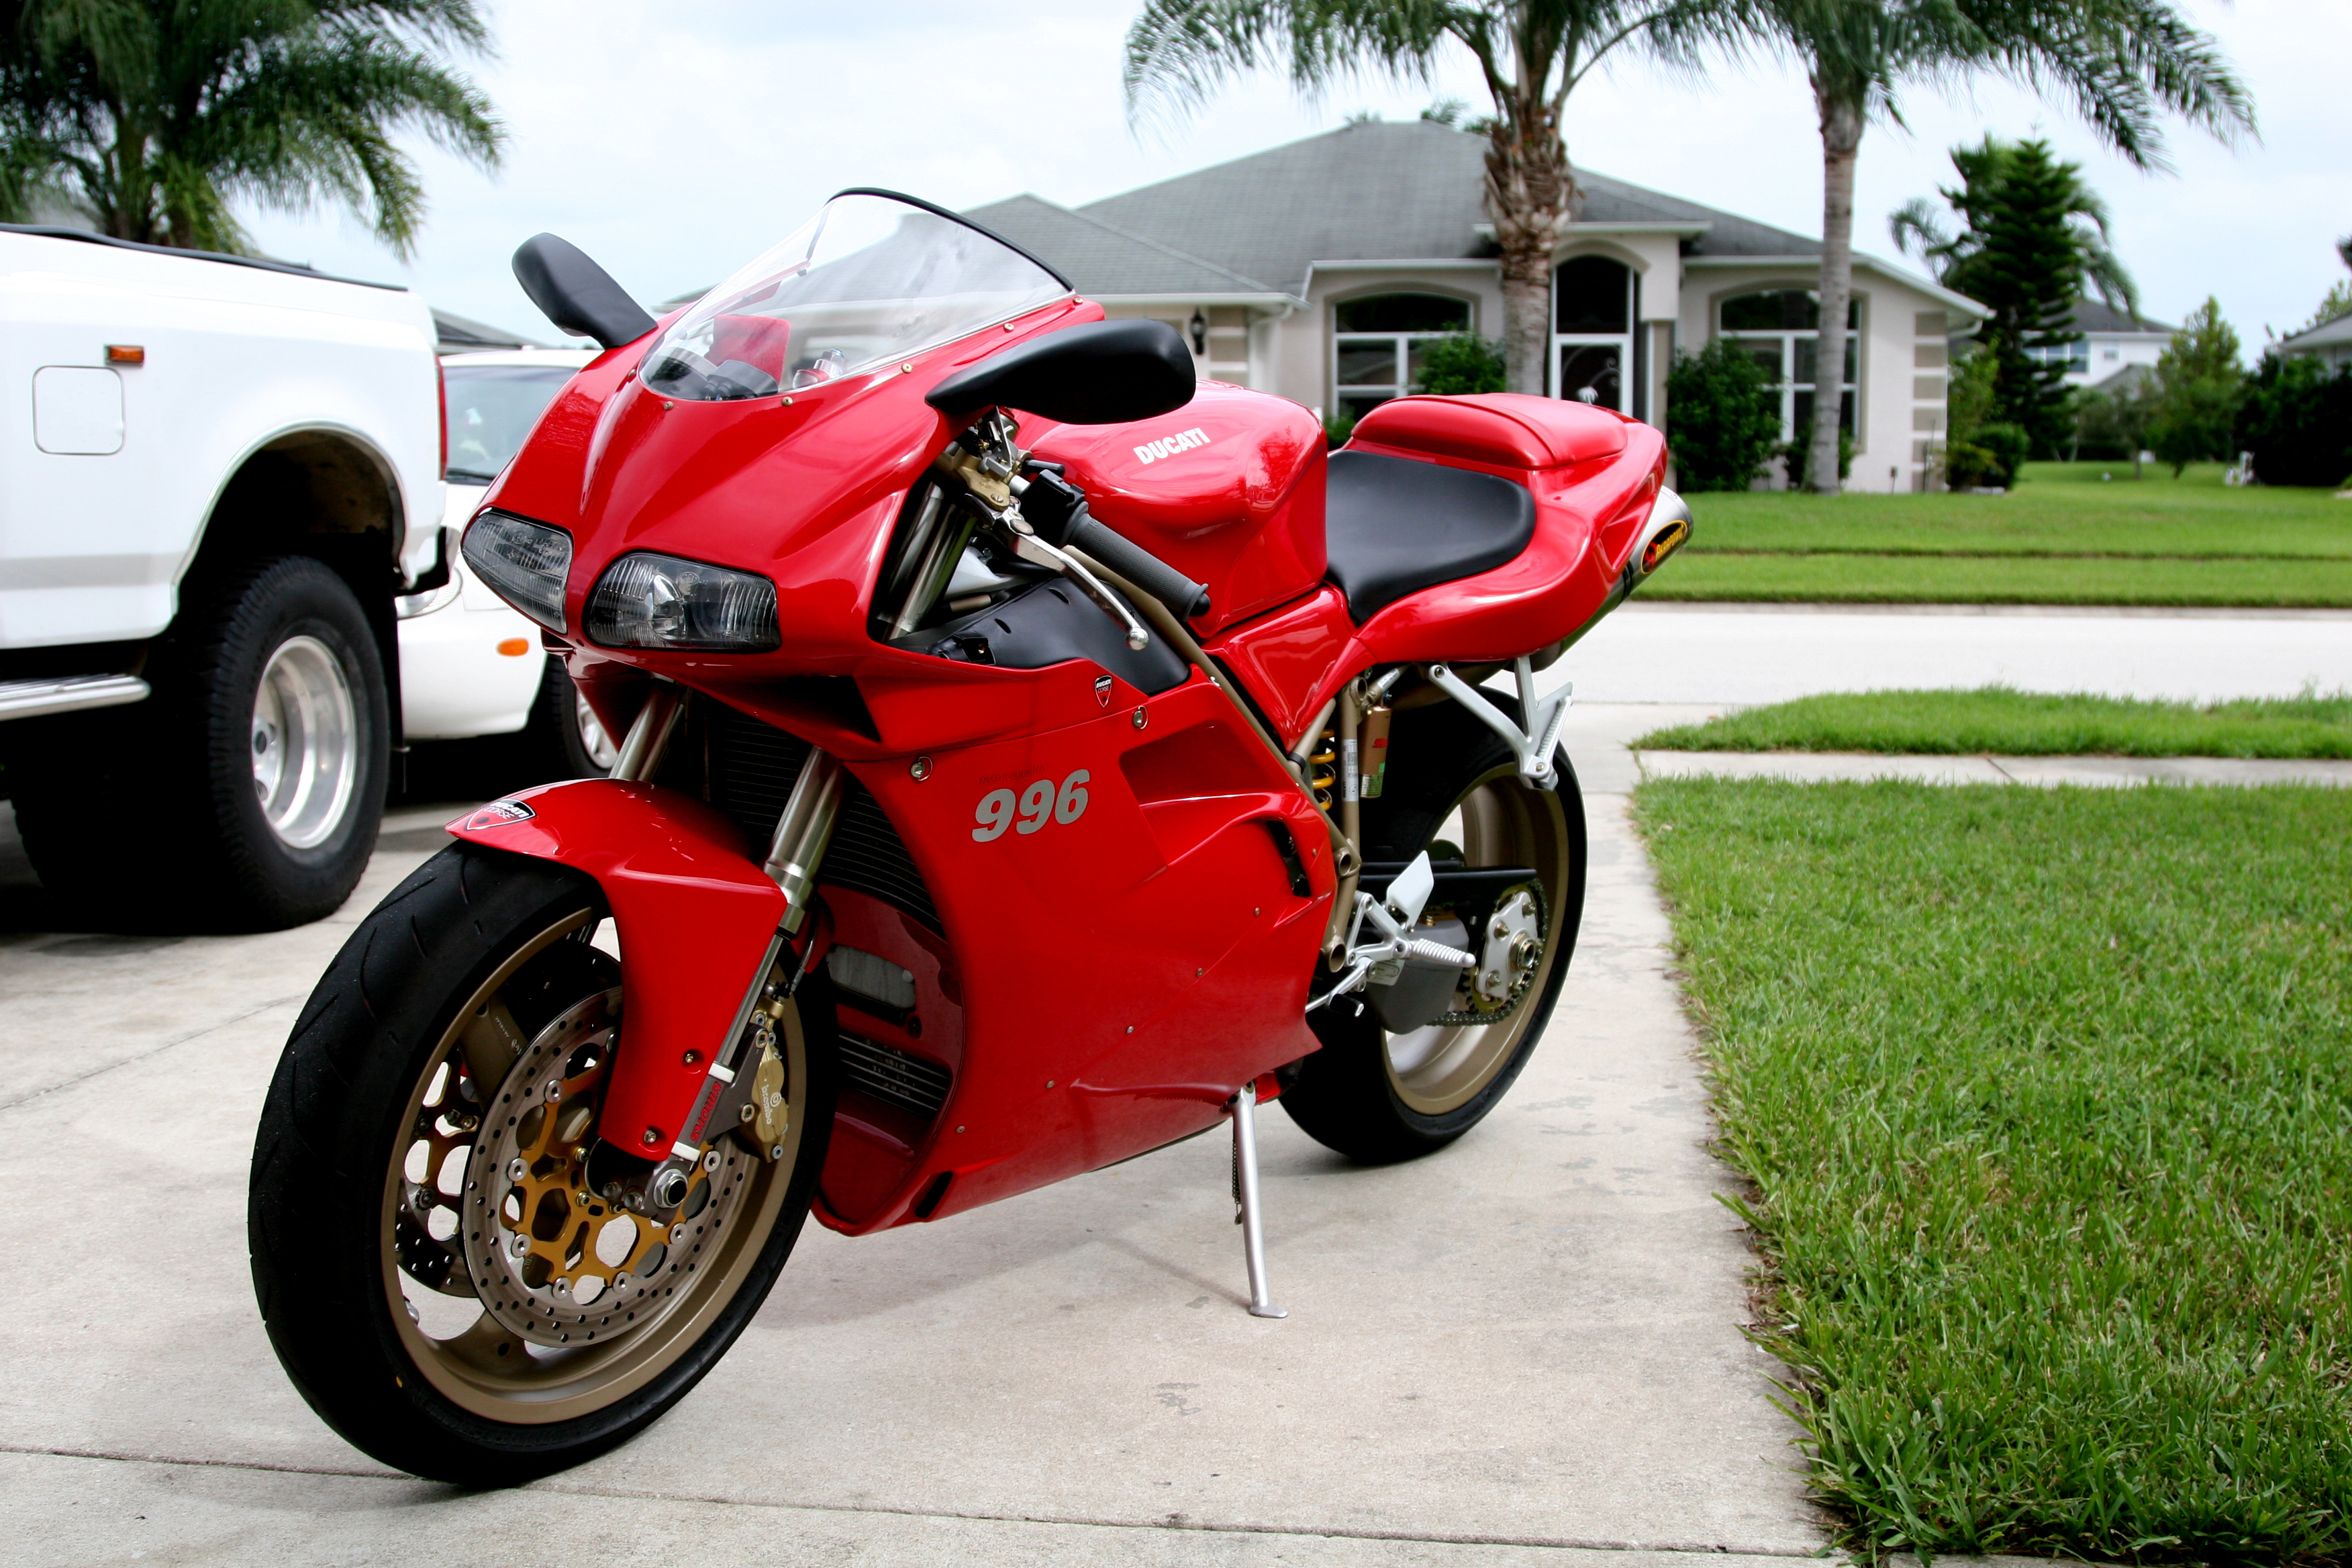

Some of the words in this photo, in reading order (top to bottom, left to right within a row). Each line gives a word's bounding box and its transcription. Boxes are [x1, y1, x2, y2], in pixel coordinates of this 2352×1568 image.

[1133, 427, 1211, 464] DUCATI
[1096, 679, 1112, 688] DUCATI
[483, 807, 515, 820] CORSE
[489, 801, 530, 818] DUCATI
[972, 769, 1090, 842] 996
[690, 1081, 722, 1144] SHOWA
[761, 1084, 773, 1125] brembo
